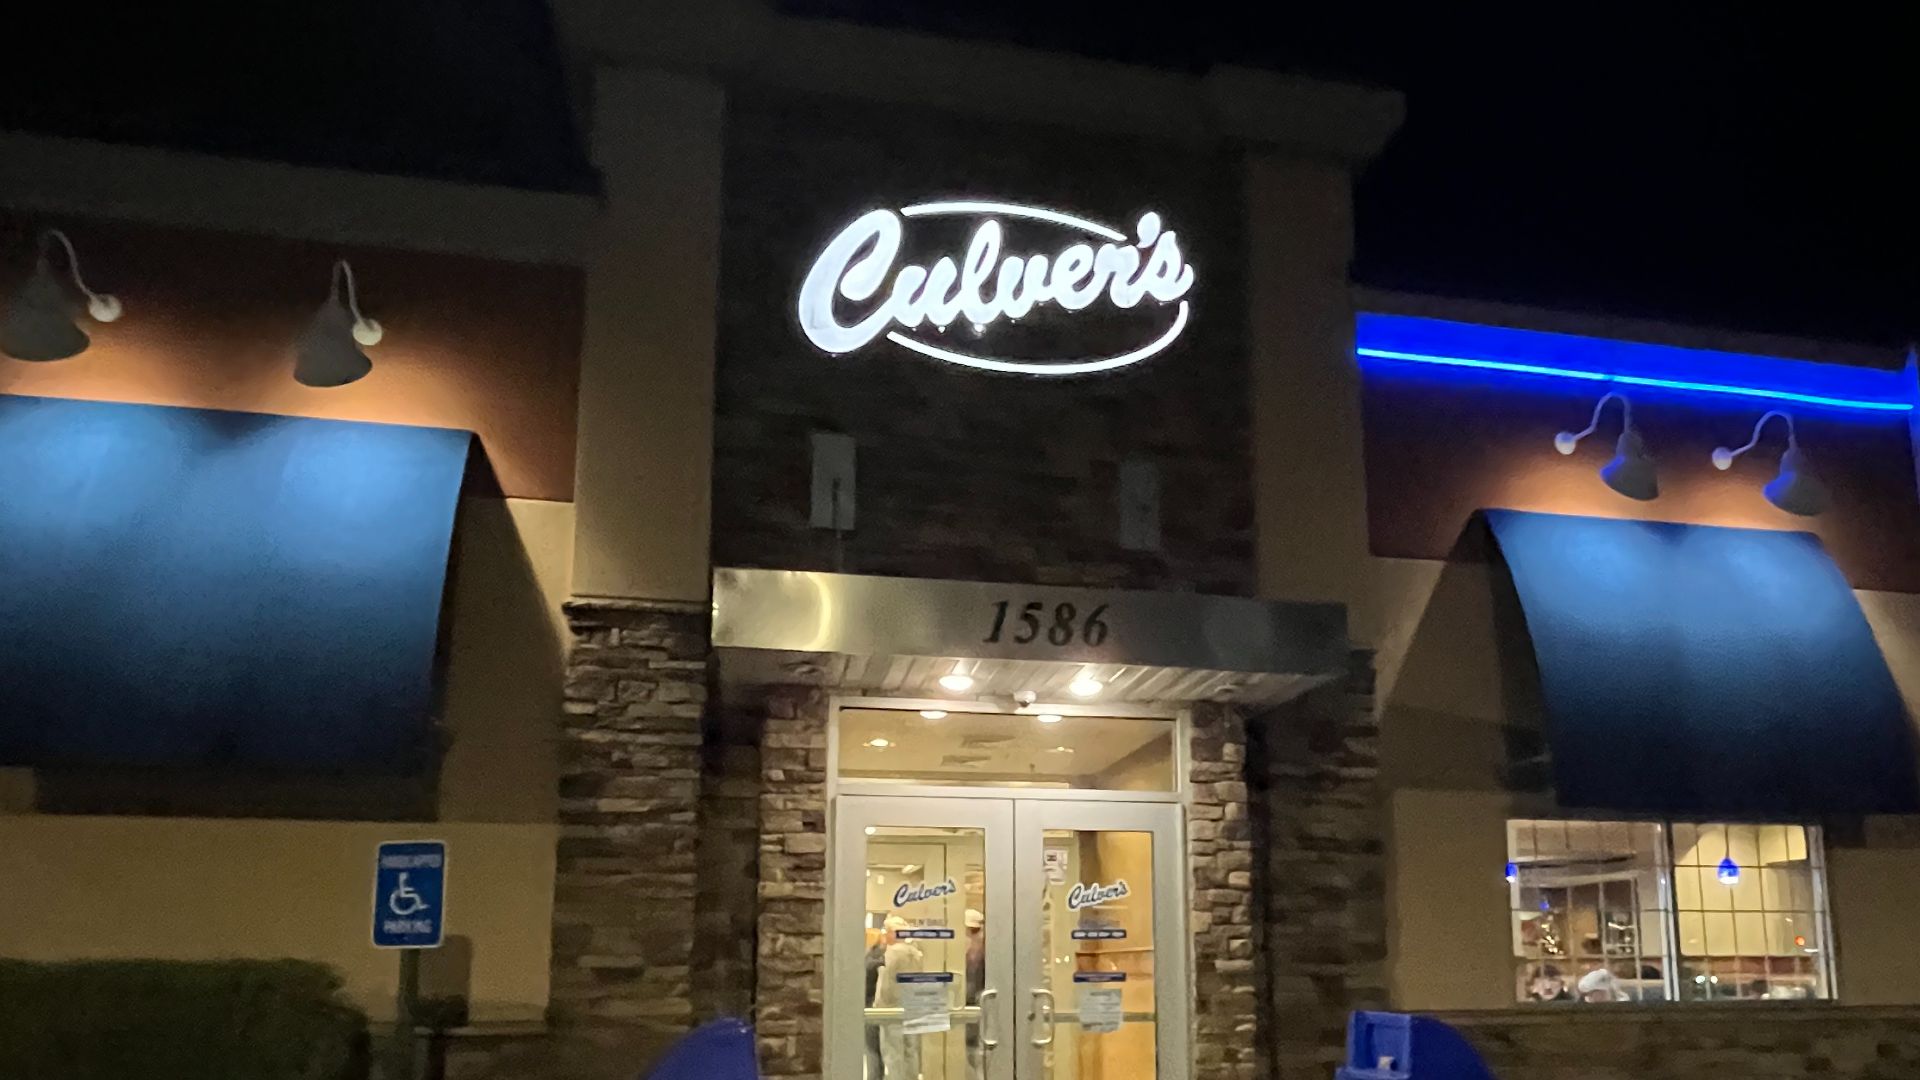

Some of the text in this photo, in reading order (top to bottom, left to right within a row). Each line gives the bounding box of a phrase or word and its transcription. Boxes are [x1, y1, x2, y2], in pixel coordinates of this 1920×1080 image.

[799, 209, 1194, 353] Culver's
[983, 601, 1109, 646] 1586
[893, 878, 956, 908] Culver's
[1068, 881, 1128, 909] Culver's
